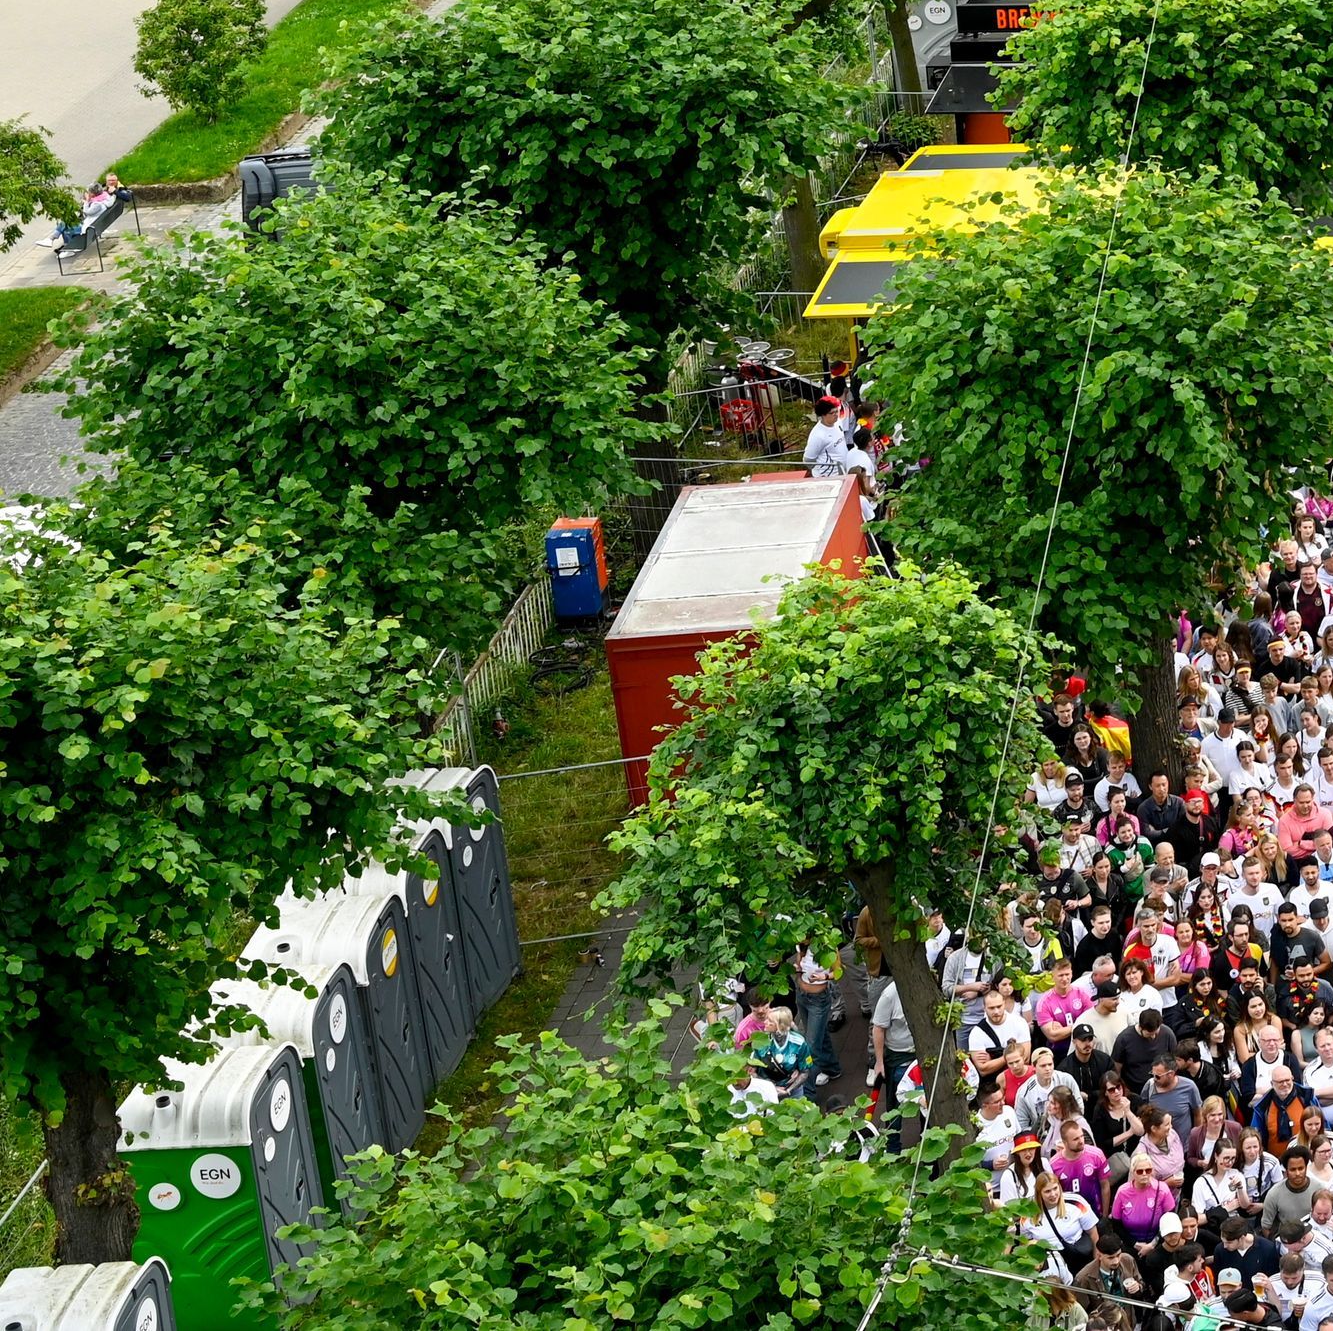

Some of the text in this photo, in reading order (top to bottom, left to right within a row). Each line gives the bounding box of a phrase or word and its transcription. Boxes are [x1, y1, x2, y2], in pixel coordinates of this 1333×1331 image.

[274, 1090, 287, 1115] EGN
[200, 1168, 231, 1181] EGN
[1072, 1178, 1080, 1193] 8
